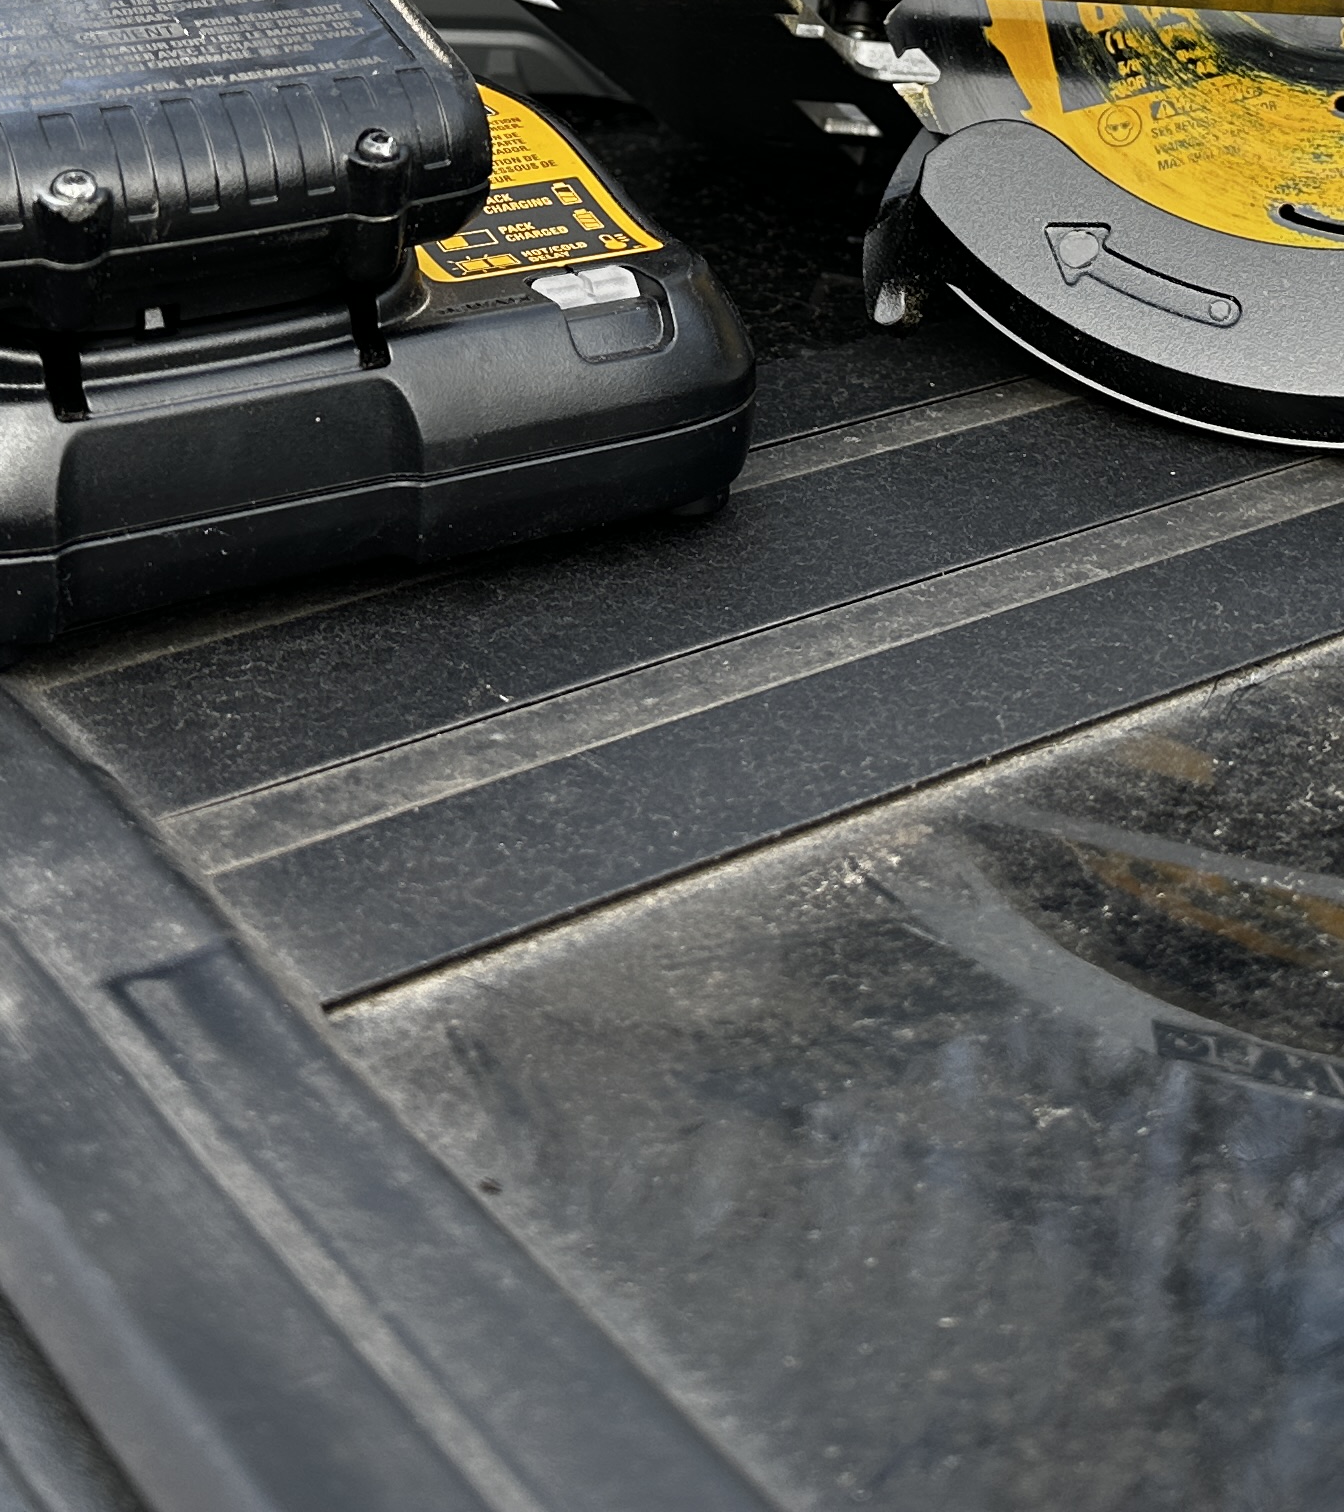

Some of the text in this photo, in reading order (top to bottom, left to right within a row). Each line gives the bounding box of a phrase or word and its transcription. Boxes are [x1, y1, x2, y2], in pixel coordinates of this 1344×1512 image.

[522, 153, 539, 162] DE
[492, 159, 558, 176] ESSOUS DE
[482, 196, 554, 216] CHARGING
[485, 192, 514, 206] ACK
[497, 221, 536, 235] PACK
[504, 225, 570, 244] CHARGED
[520, 241, 589, 258] HOT/COLD
[528, 251, 572, 264] DELAY
